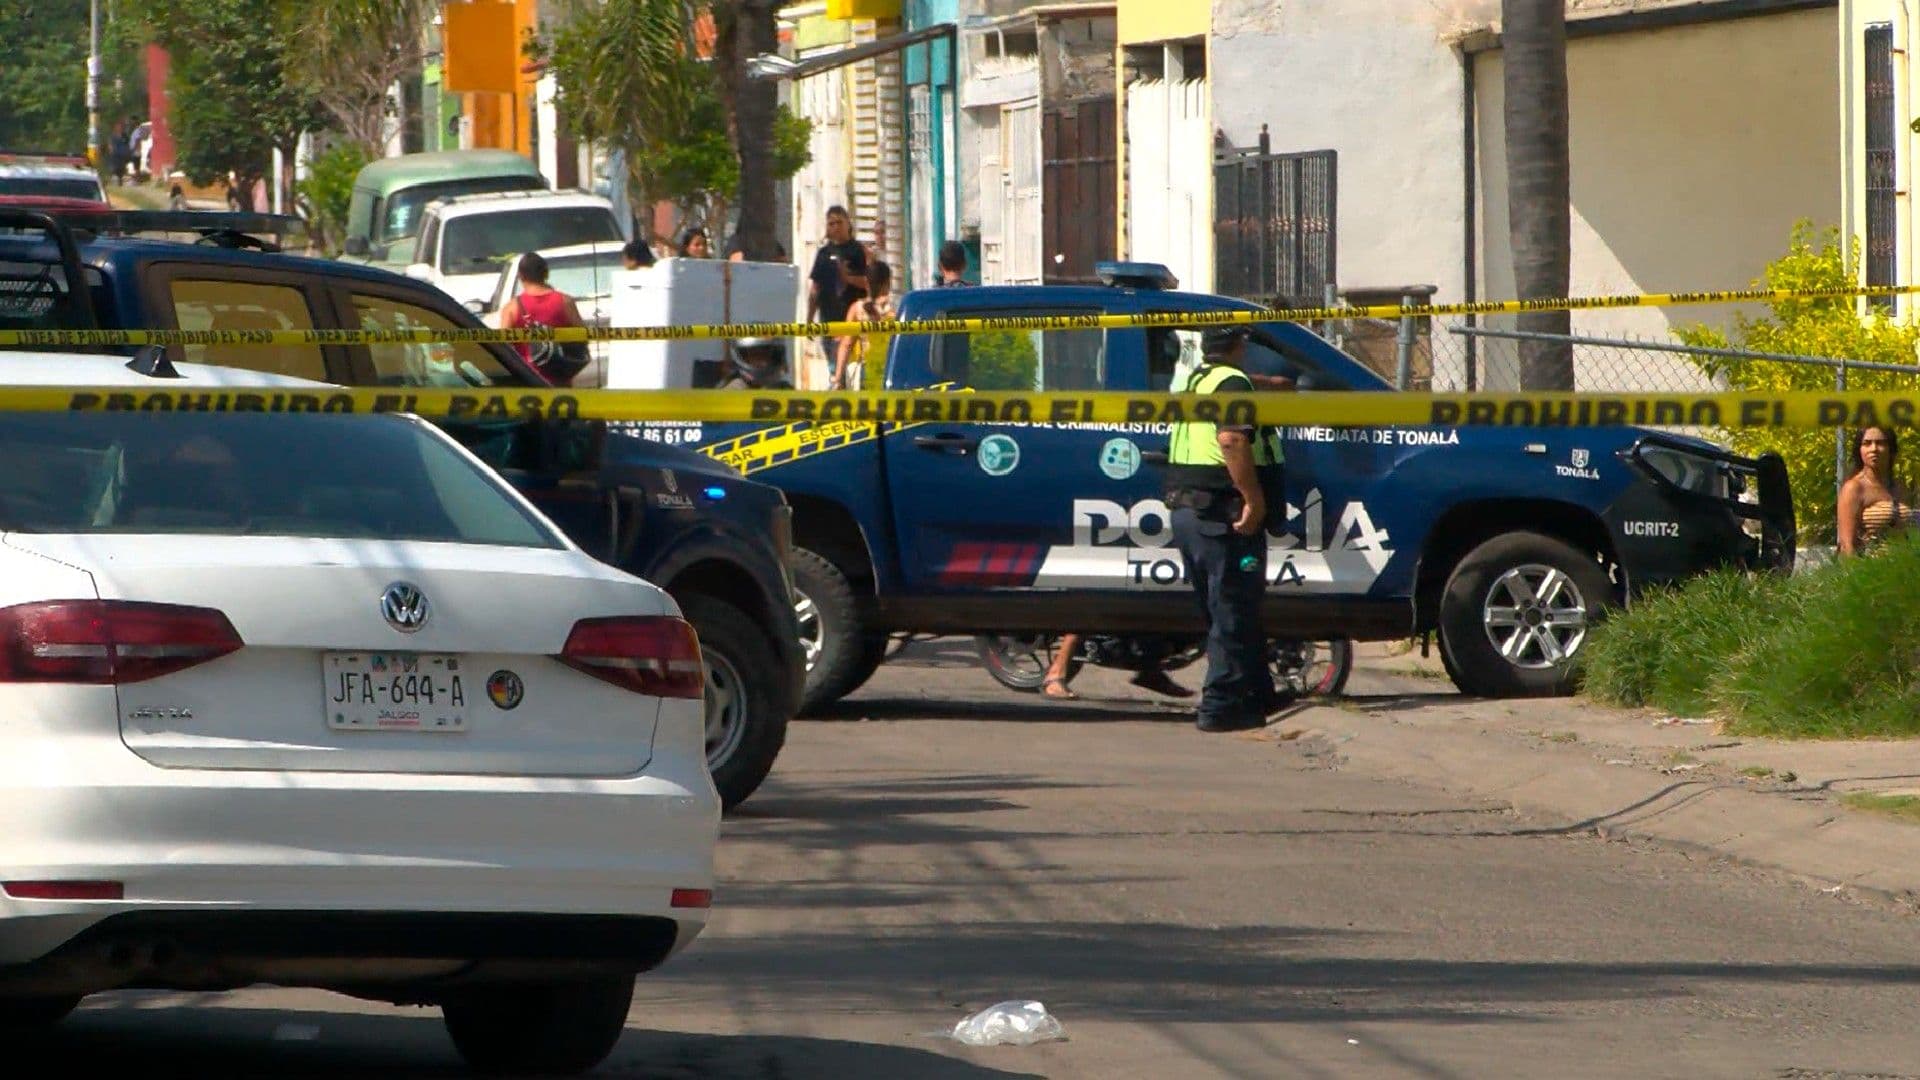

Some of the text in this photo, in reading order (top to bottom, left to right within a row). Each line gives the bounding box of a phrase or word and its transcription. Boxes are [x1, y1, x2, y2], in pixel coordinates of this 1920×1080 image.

[59, 331, 73, 344] DE
[1817, 399, 1920, 426] PAS
[664, 428, 681, 444] 61
[800, 420, 866, 443] ESCENA
[1287, 425, 1369, 444] INMEDIATA
[1373, 429, 1393, 445] DE
[1397, 428, 1460, 445] TONALÁ
[1073, 488, 1392, 555] POÍA
[1623, 520, 1680, 538] UCRIT-2
[1127, 554, 1306, 587] TOÁ
[333, 672, 464, 707] JFA-644-A
